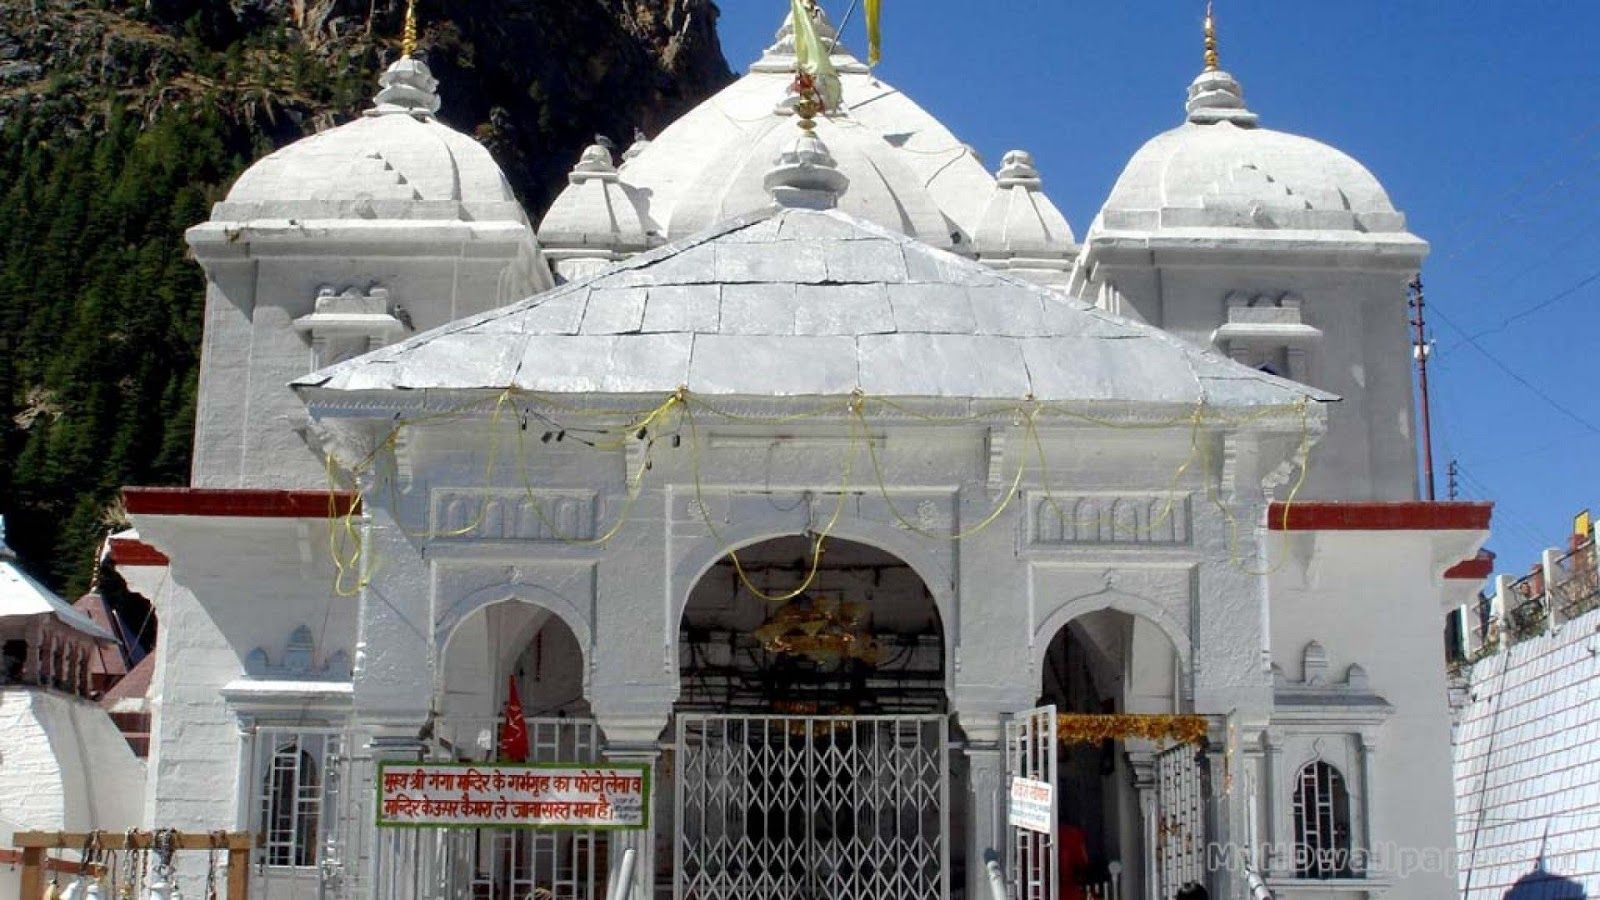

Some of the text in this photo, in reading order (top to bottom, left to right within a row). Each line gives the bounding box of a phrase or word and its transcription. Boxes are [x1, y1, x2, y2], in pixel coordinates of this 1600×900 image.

[383, 773, 408, 793] मुख्य
[409, 769, 426, 790] श्री
[429, 770, 454, 790] गंगा
[457, 768, 490, 793] मन्दिर
[493, 769, 506, 791] के
[554, 776, 572, 792] का
[574, 770, 605, 793] फोटो
[605, 770, 630, 795] लेना
[422, 795, 433, 816] के
[494, 795, 507, 819] ले
[511, 801, 541, 818] जाना
